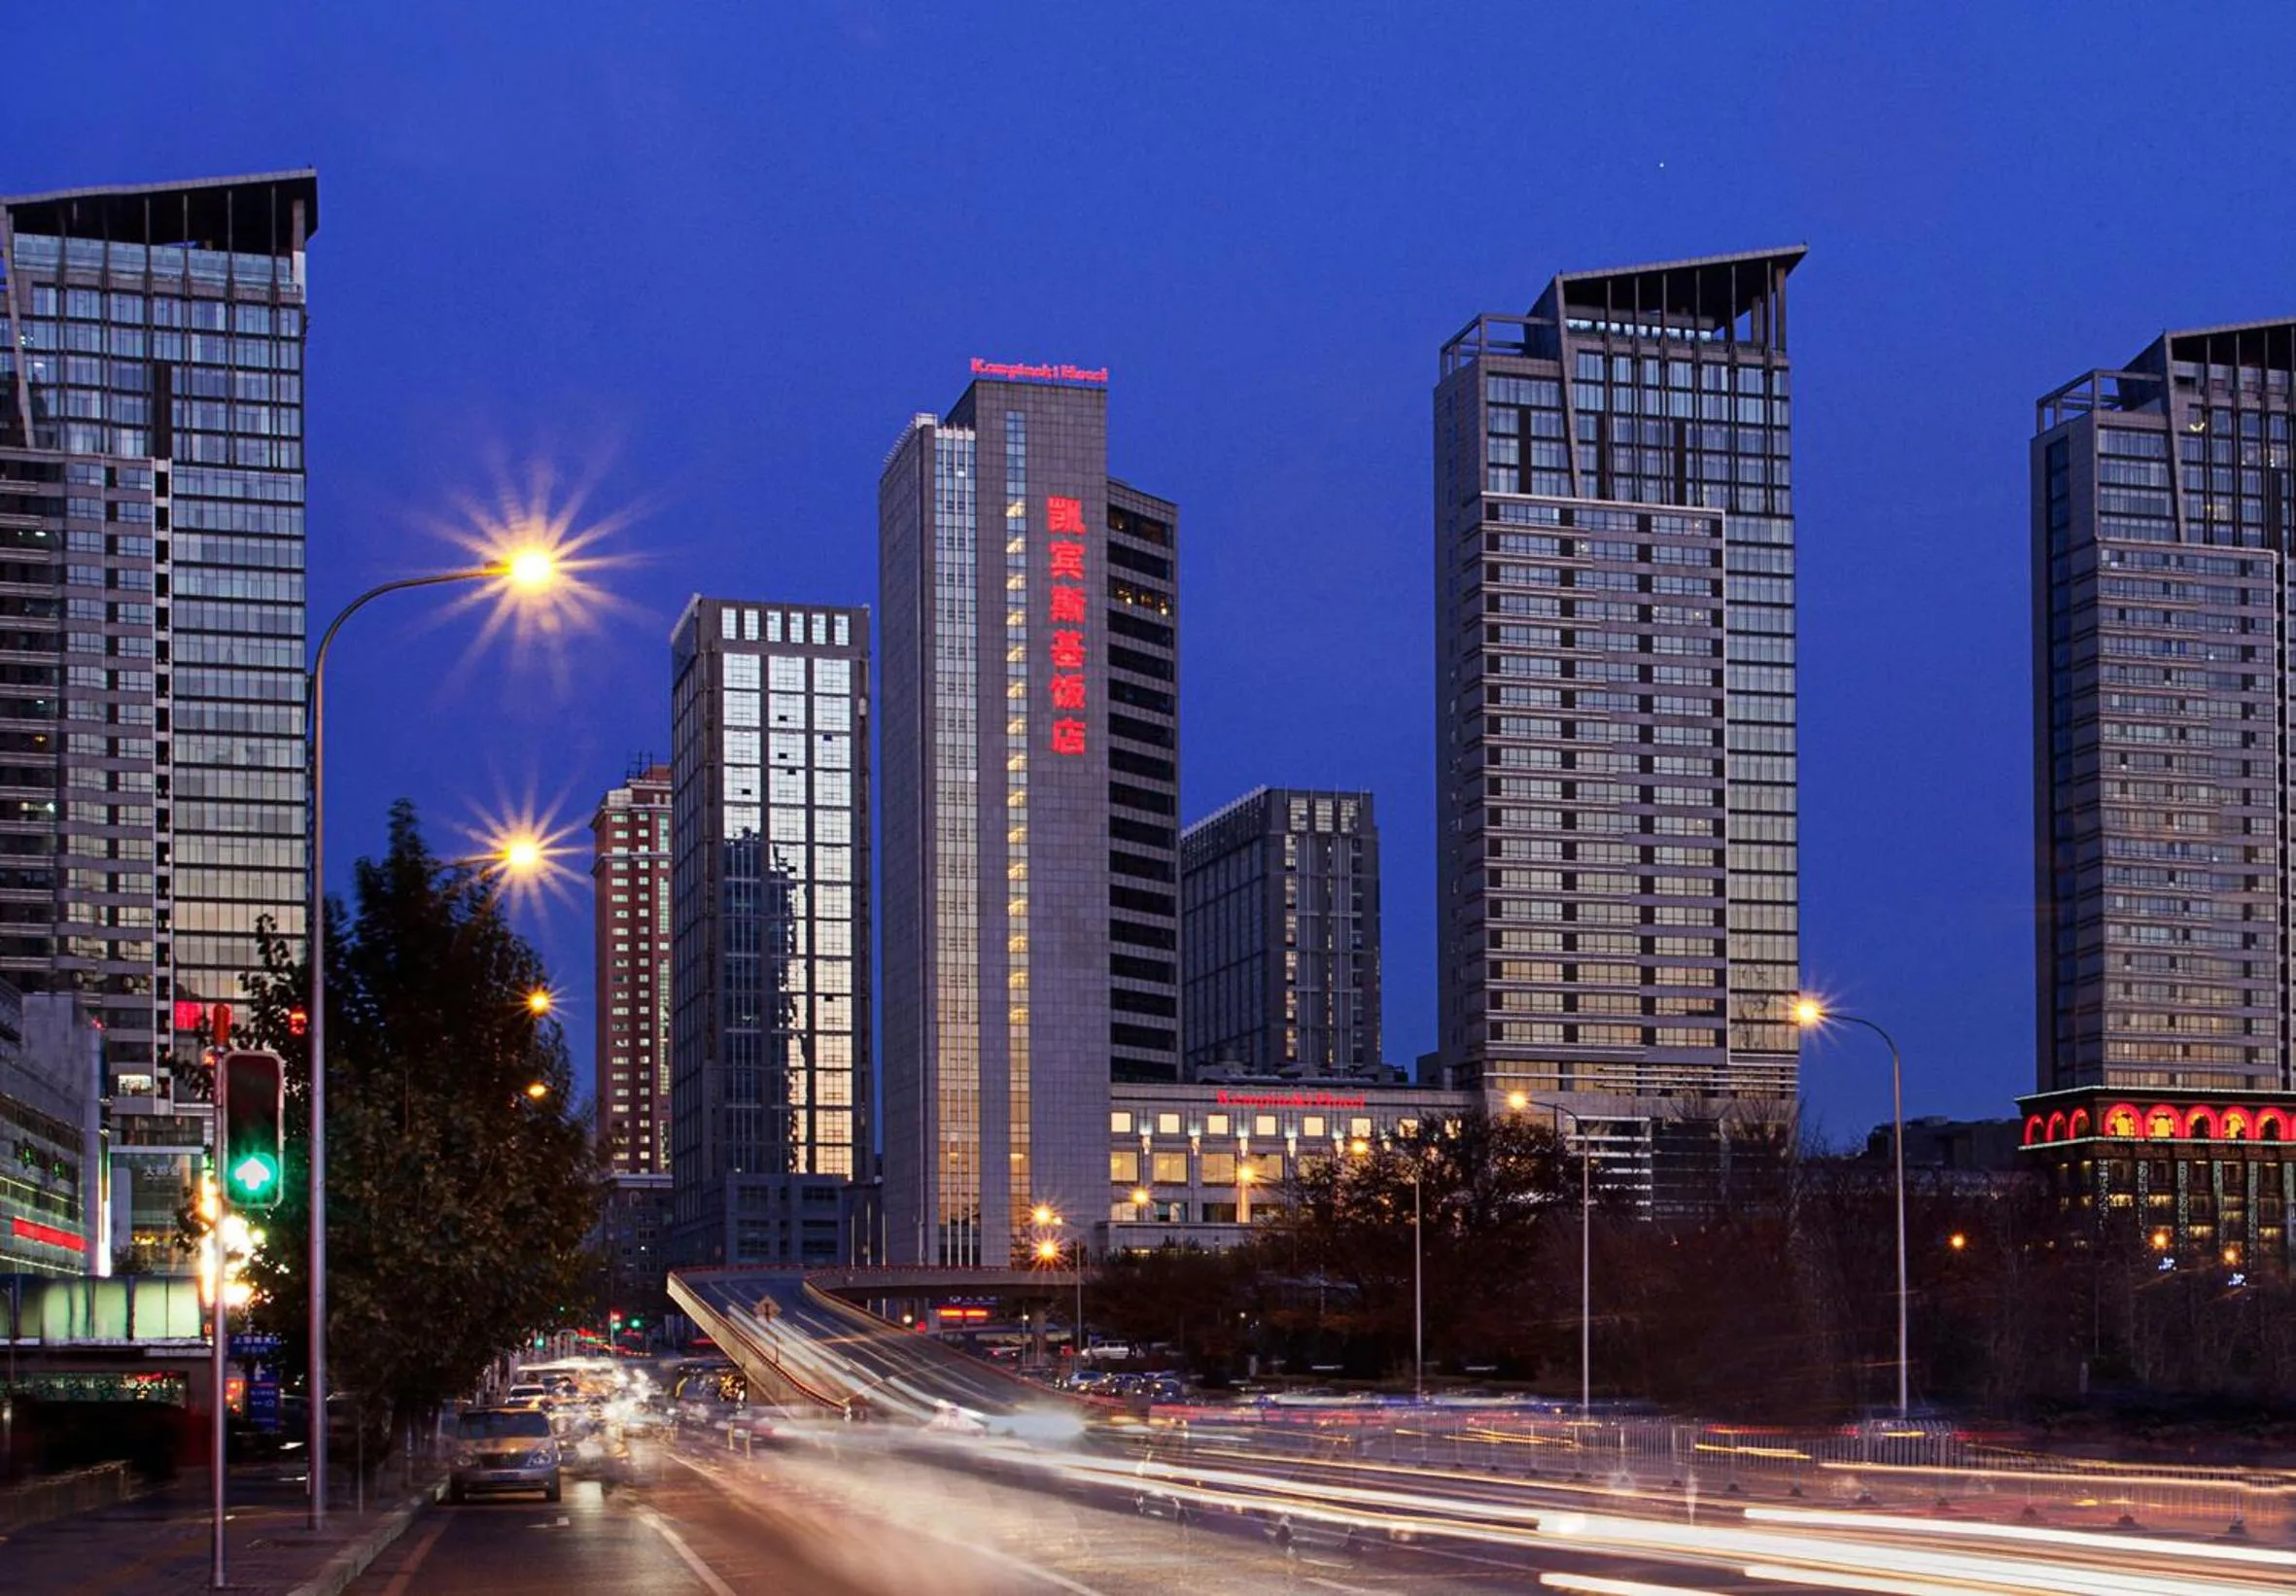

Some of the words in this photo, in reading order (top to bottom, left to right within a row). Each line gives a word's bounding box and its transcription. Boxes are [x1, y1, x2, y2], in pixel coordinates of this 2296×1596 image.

[1046, 496, 1087, 755] 凯宾斯基饭店
